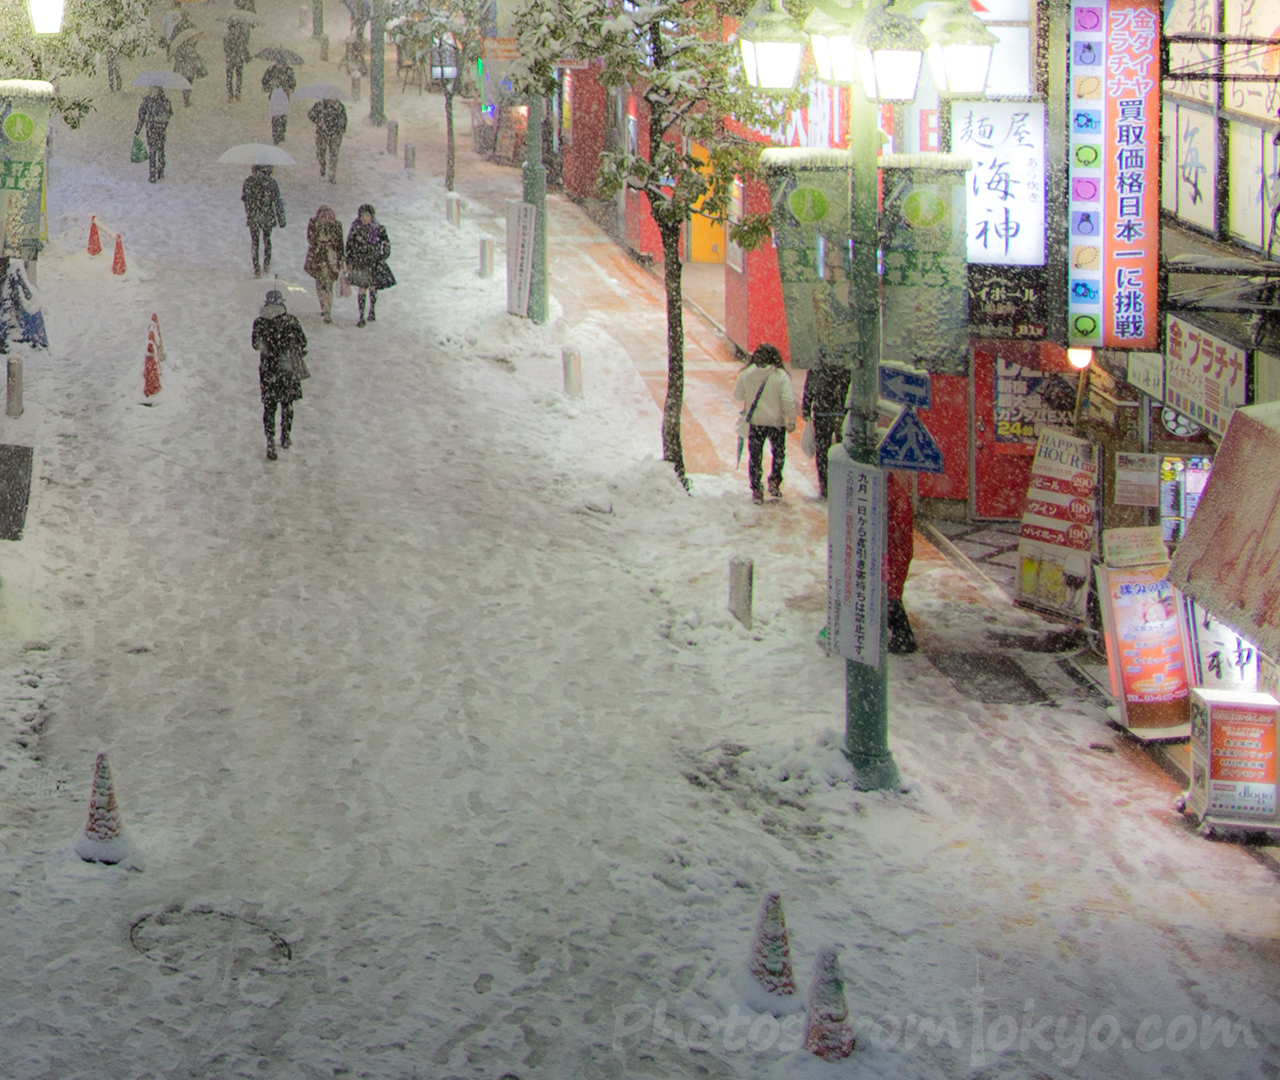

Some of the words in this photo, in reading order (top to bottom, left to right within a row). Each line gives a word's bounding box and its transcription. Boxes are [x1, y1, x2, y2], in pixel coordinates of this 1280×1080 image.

[959, 108, 1037, 152] 麺屋
[970, 156, 1022, 258] 海神
[1114, 99, 1146, 340] 買取価格日本一に挑戦
[1167, 319, 1244, 388] 金・プラチナ
[1040, 433, 1081, 455] HAPPY
[1038, 446, 1080, 469] HOUR
[1071, 476, 1093, 489] 290
[1070, 502, 1091, 515] 190
[1067, 527, 1090, 541] 190
